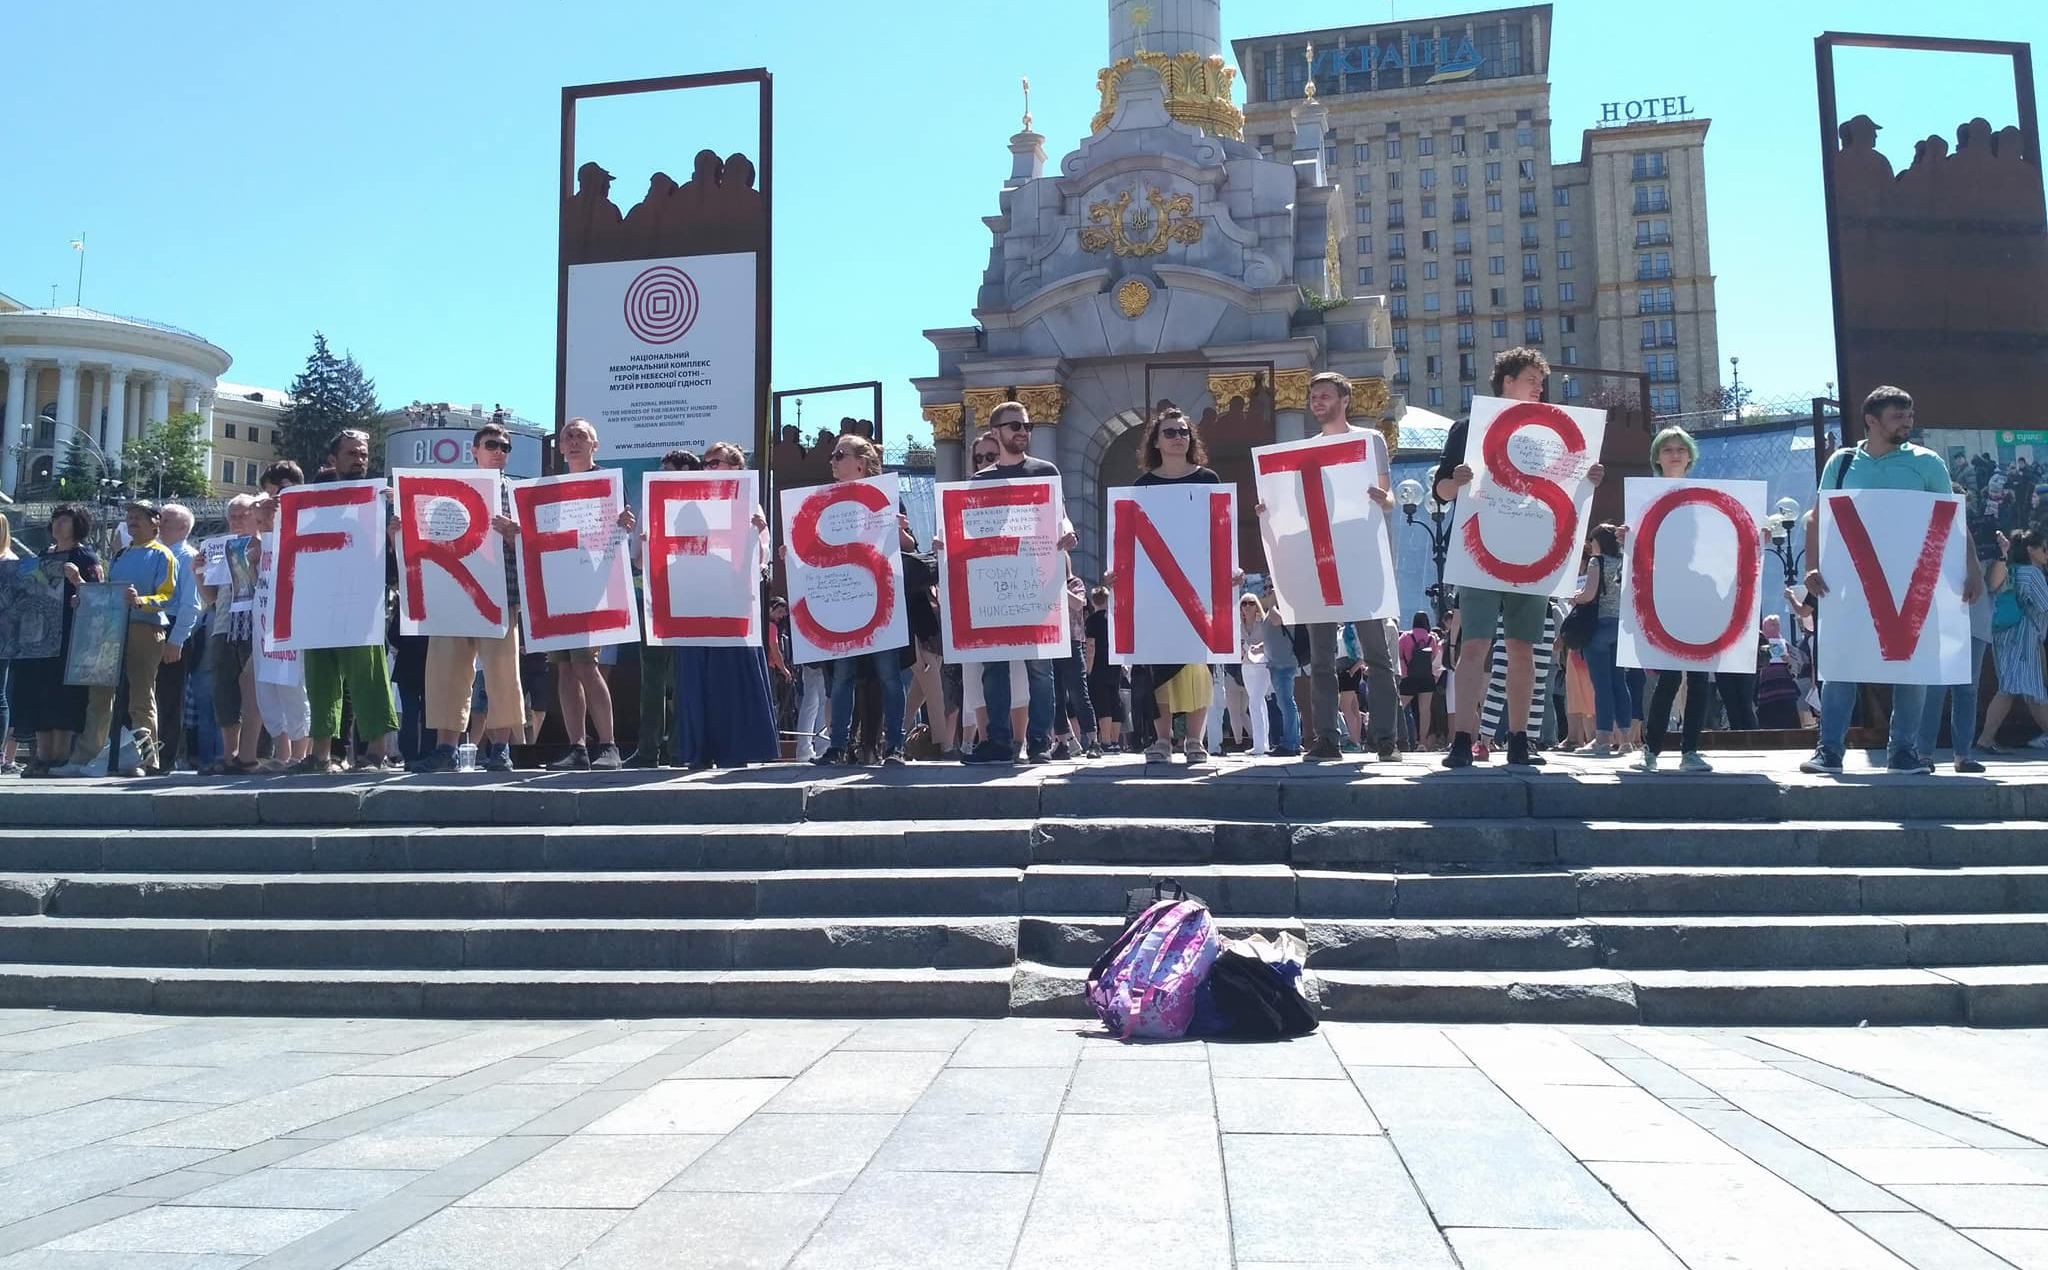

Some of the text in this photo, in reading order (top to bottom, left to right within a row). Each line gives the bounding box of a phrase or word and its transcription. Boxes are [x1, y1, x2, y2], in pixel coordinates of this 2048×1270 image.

[1310, 34, 1482, 77] УКРАЇНА
[1601, 96, 1695, 122] HOTEL
[609, 360, 711, 372] МЕМОРІАЛЬНИЙ КОМПЛЕКС
[614, 373, 640, 382] ГЕРОЇВ
[641, 371, 677, 380] НЕБЕСНОЇ
[678, 370, 700, 378] СОТНІ
[630, 351, 690, 362] НАЦІОНАЛЬНИЙ
[609, 379, 712, 392] МУЗЕЙ РЕВОЛЮЦІЇ ГІДНОСТІ
[414, 438, 474, 464] GLOB
[615, 439, 705, 451] www.maidanmuseum.org
[1461, 402, 1587, 585] S
[1258, 439, 1367, 607] T
[272, 485, 376, 642] F
[399, 476, 502, 625] R
[513, 478, 630, 638] E
[648, 480, 749, 639] E
[791, 482, 895, 654] S
[942, 484, 1062, 650] E
[976, 567, 1047, 580] TODAY IS
[1023, 579, 1048, 593] DAY
[1112, 493, 1235, 654] N
[1632, 487, 1760, 661] O
[1828, 495, 1959, 662] V
[977, 601, 1062, 618] HUNGERSTRIKE
[997, 592, 1013, 601] OF
